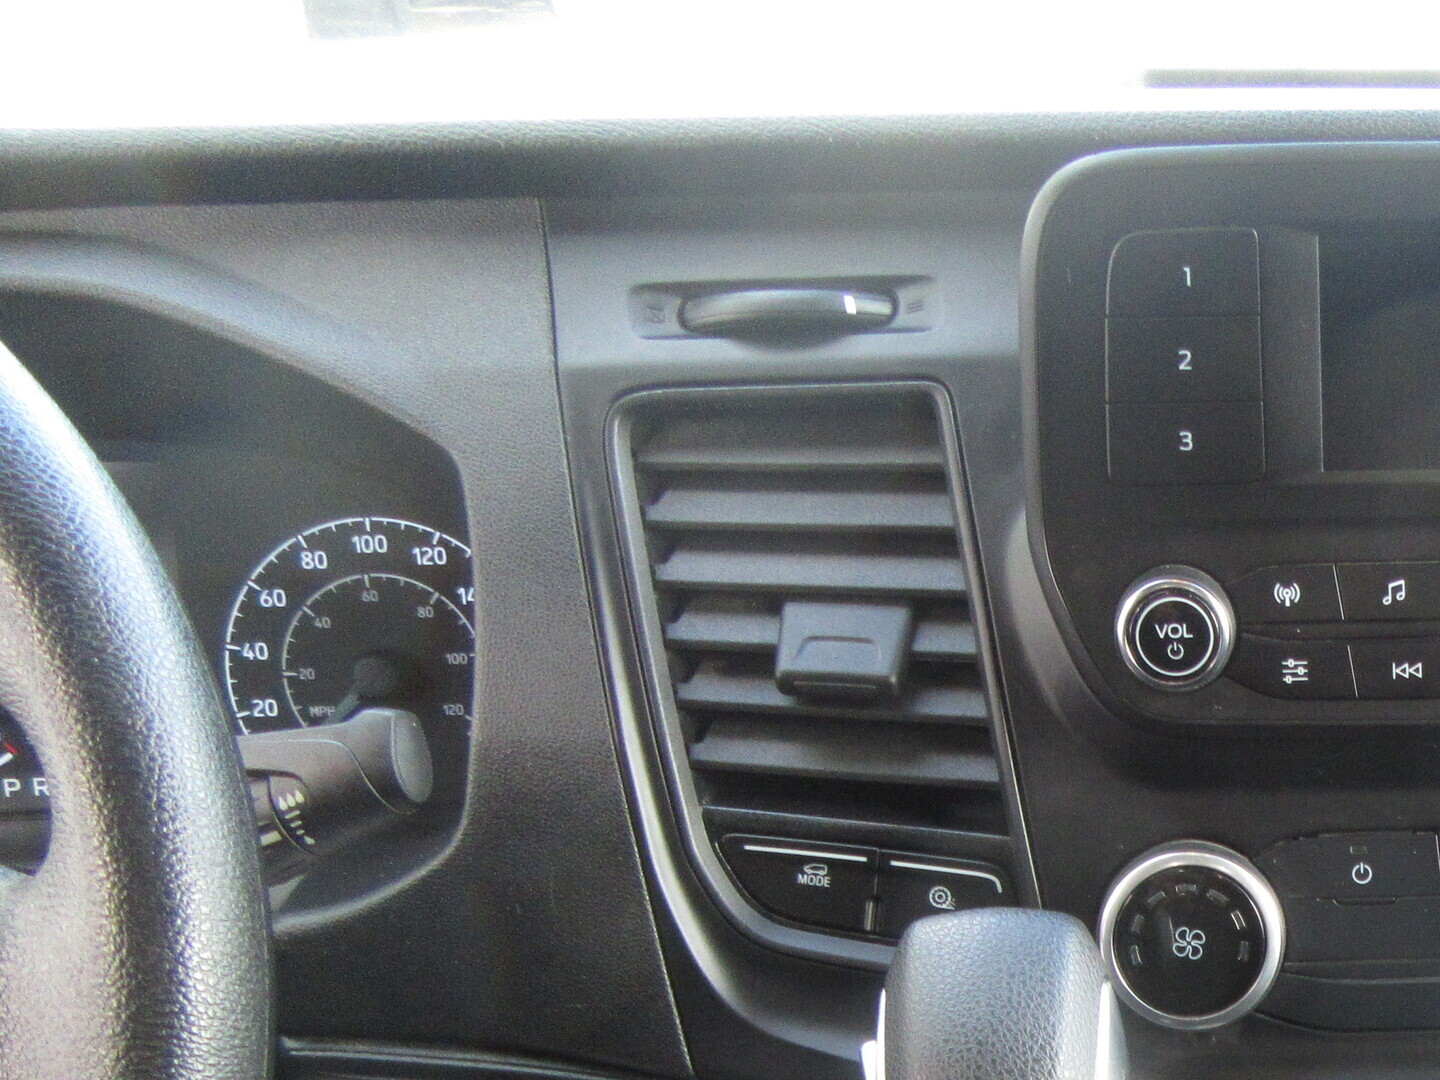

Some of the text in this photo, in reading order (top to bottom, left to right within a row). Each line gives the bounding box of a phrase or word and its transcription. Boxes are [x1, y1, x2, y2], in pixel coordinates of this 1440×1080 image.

[1182, 266, 1192, 287] 1
[1178, 349, 1193, 371] 2
[1178, 430, 1194, 452] 3
[351, 534, 388, 554] 100
[300, 550, 329, 570] 80
[411, 546, 448, 566] 120
[258, 588, 287, 608] 60
[360, 590, 379, 602] 60
[457, 587, 475, 606] 14
[416, 606, 435, 618] 80
[313, 617, 331, 629] 40
[1153, 622, 1195, 640] VOL
[241, 642, 269, 661] 40
[445, 652, 468, 665] 100
[299, 667, 315, 680] 20
[251, 699, 279, 718] 20
[308, 704, 335, 717] MPH
[442, 703, 464, 716] 120
[3, 777, 51, 798] P R
[797, 872, 832, 888] MODE
